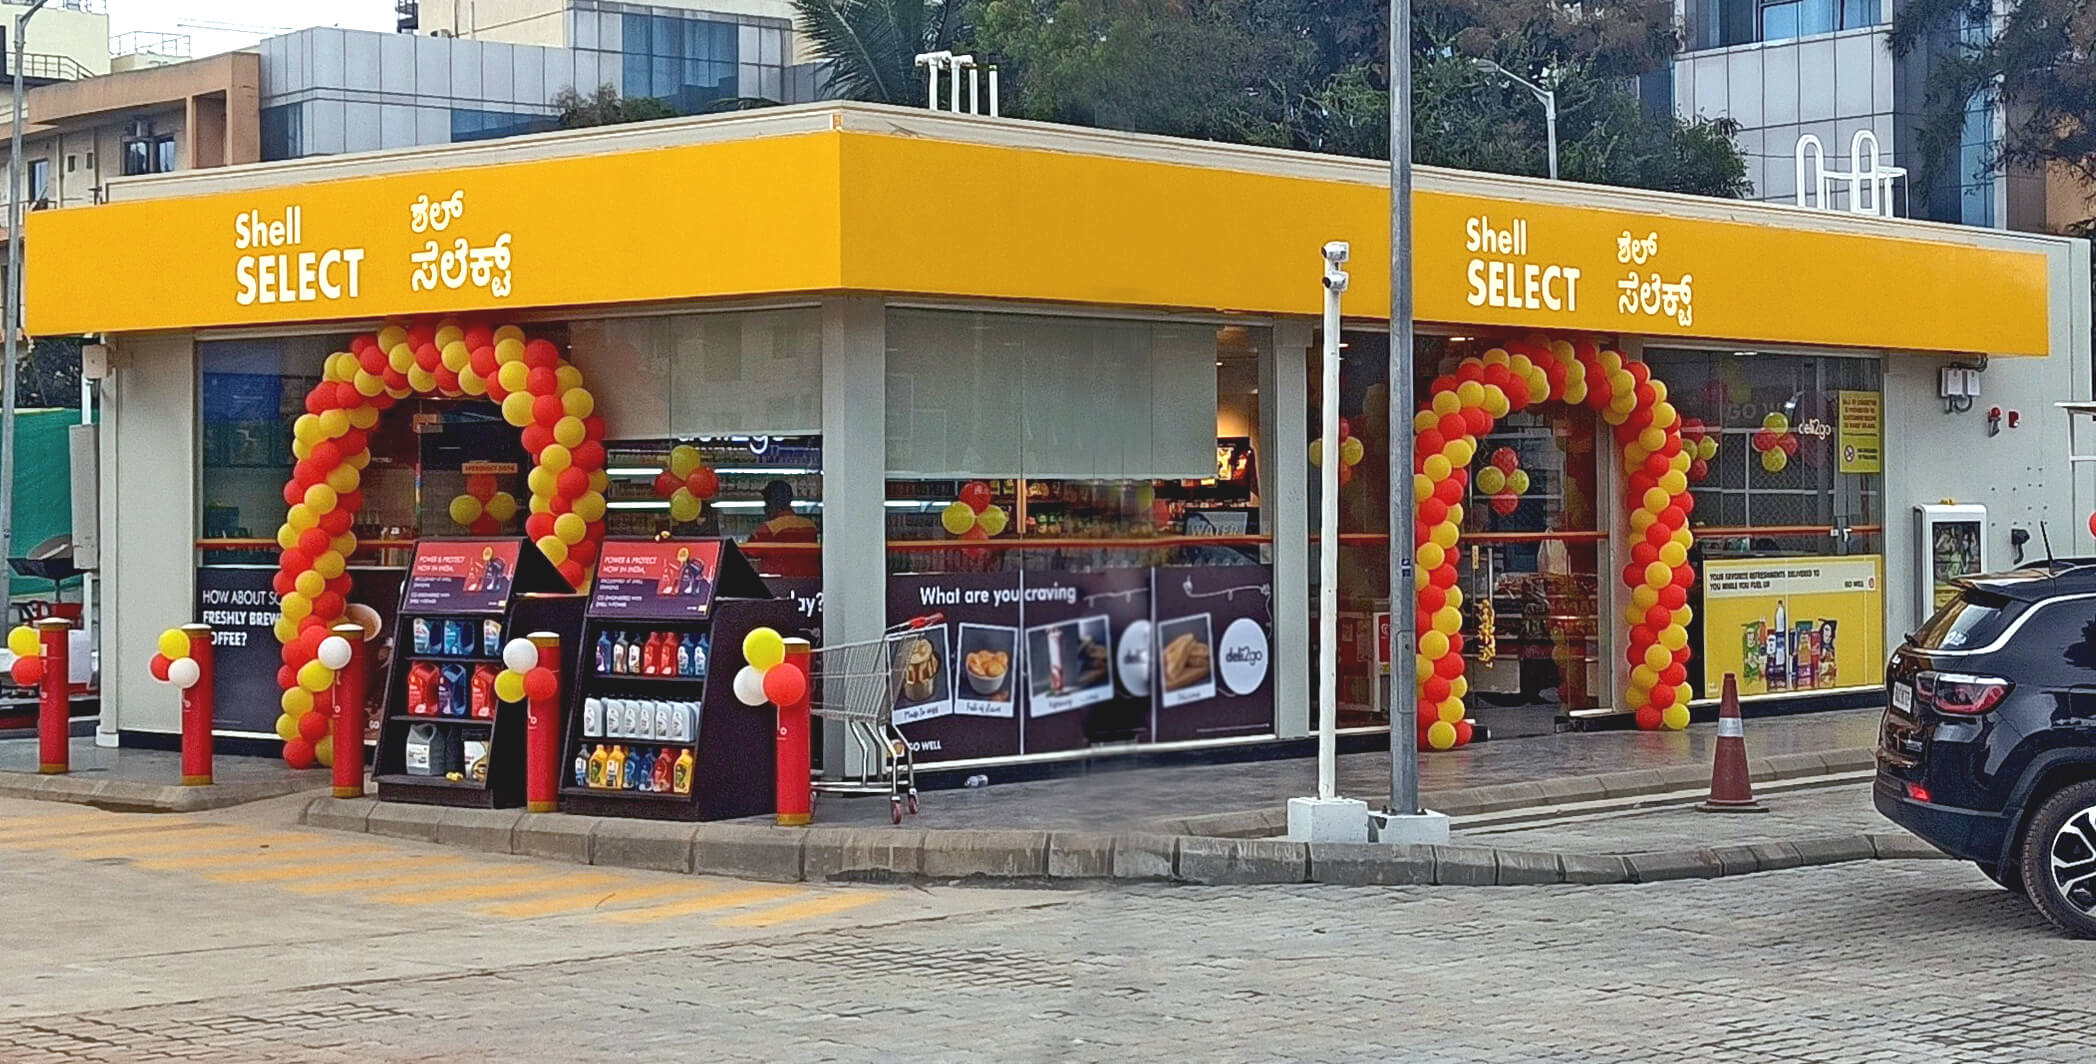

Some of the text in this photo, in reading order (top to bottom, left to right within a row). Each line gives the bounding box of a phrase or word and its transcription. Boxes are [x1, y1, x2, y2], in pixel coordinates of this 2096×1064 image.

[235, 205, 301, 249] Shell
[410, 189, 463, 233] ಶೆಲ್
[1466, 216, 1527, 255] Shell
[1617, 231, 1658, 264] ಶೆಲ್
[236, 248, 365, 305] SELECT
[410, 233, 512, 298] ಸೆಲೆಕ್ಟ್
[1467, 258, 1580, 312] SELECT
[1617, 271, 1693, 327] ಸೆಲೆಕ್ಟ್
[1798, 416, 1832, 440] deli2go
[202, 590, 229, 604] HOW
[230, 590, 267, 605] ABOUT
[920, 581, 1077, 607] What are you craving
[203, 610, 247, 625] FRESHLY
[1225, 646, 1263, 666] deli2go
[909, 740, 942, 751] GO WELL
